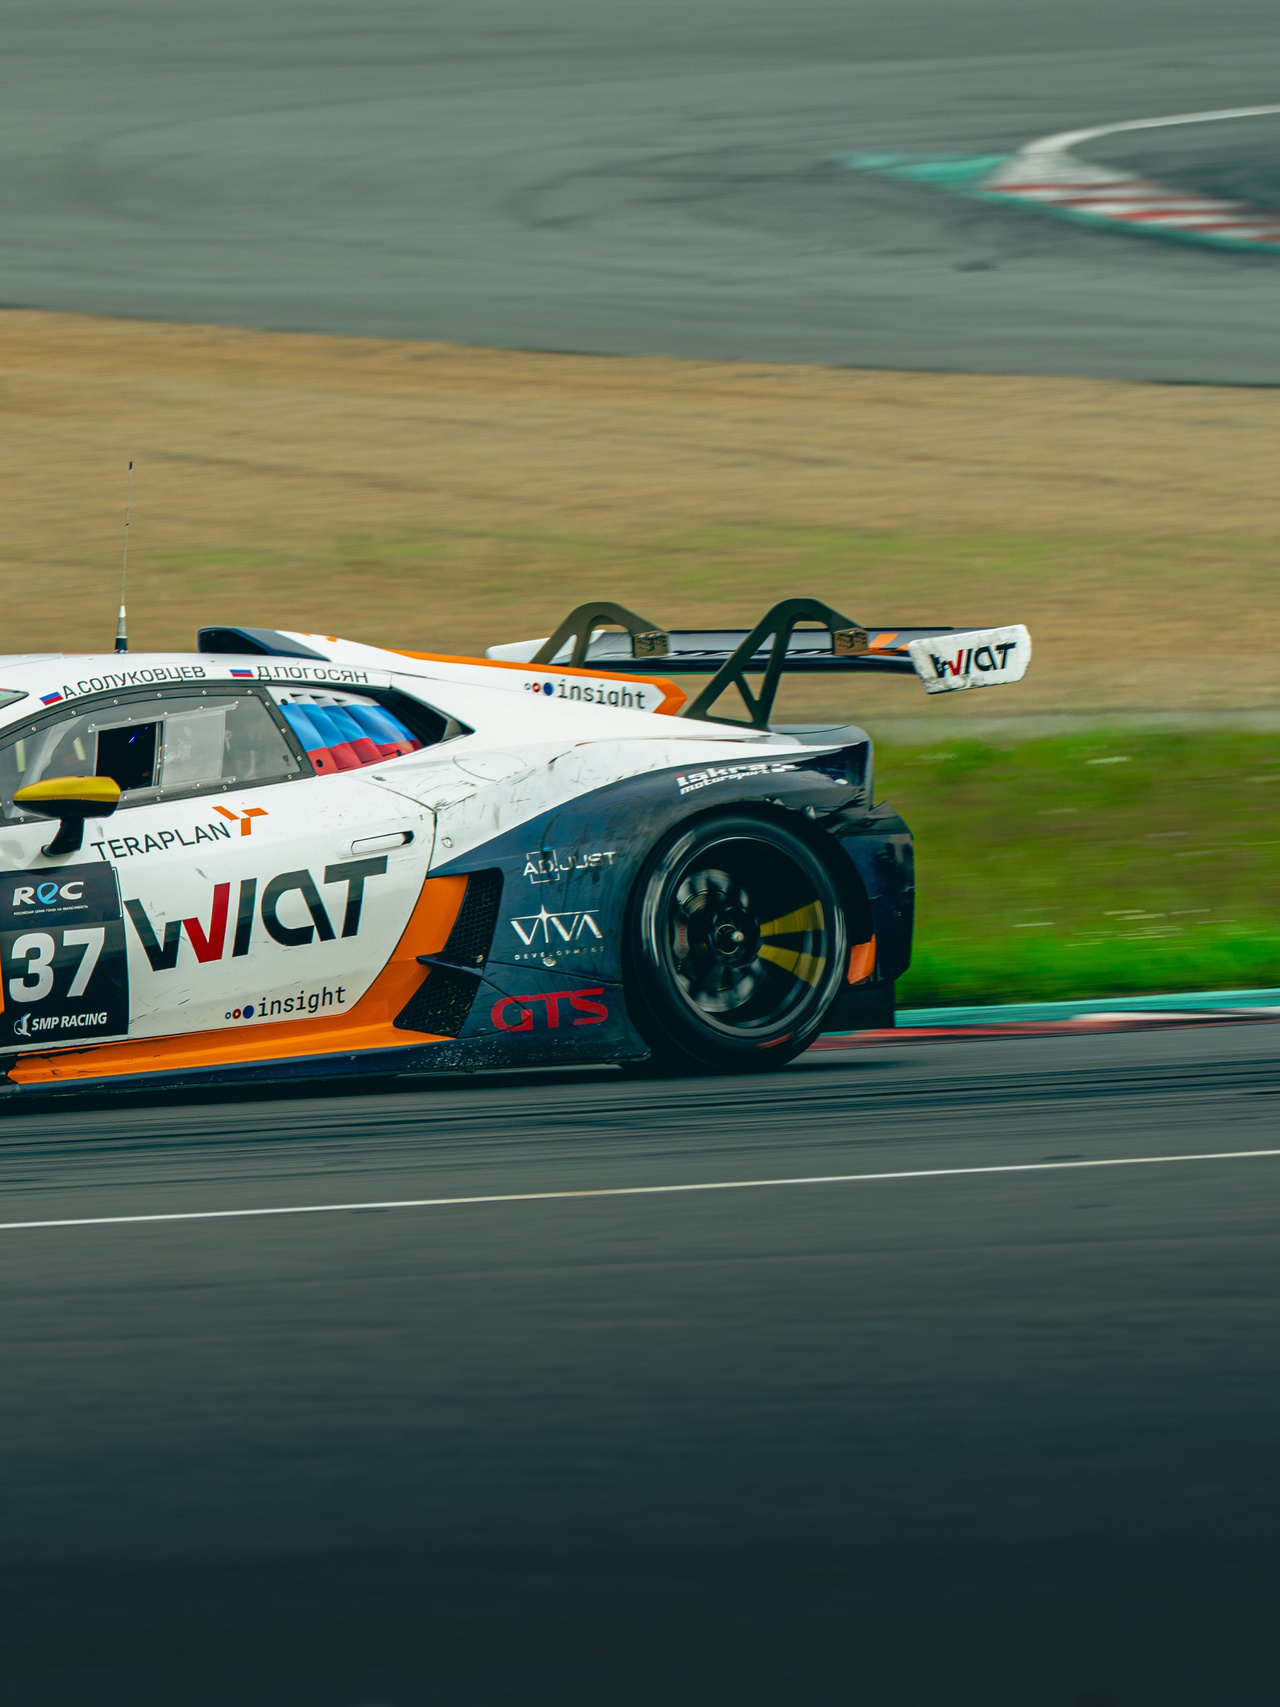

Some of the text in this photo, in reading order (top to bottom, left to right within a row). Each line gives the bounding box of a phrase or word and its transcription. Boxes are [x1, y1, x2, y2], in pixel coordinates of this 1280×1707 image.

[61, 666, 207, 699] А.СОЛУКОВЦЕВ
[257, 666, 369, 684] Д.ПОГОСЯН
[557, 679, 646, 709] insight
[675, 764, 768, 787] iskra
[680, 768, 770, 795] motorsport
[90, 822, 231, 861] TERAPLAN
[123, 855, 388, 972] WIAT
[510, 905, 604, 946] VIVA
[9, 927, 106, 1003] 37
[258, 986, 346, 1017] insight
[491, 988, 609, 1032] GTS
[32, 1012, 108, 1031] SMP RACING
